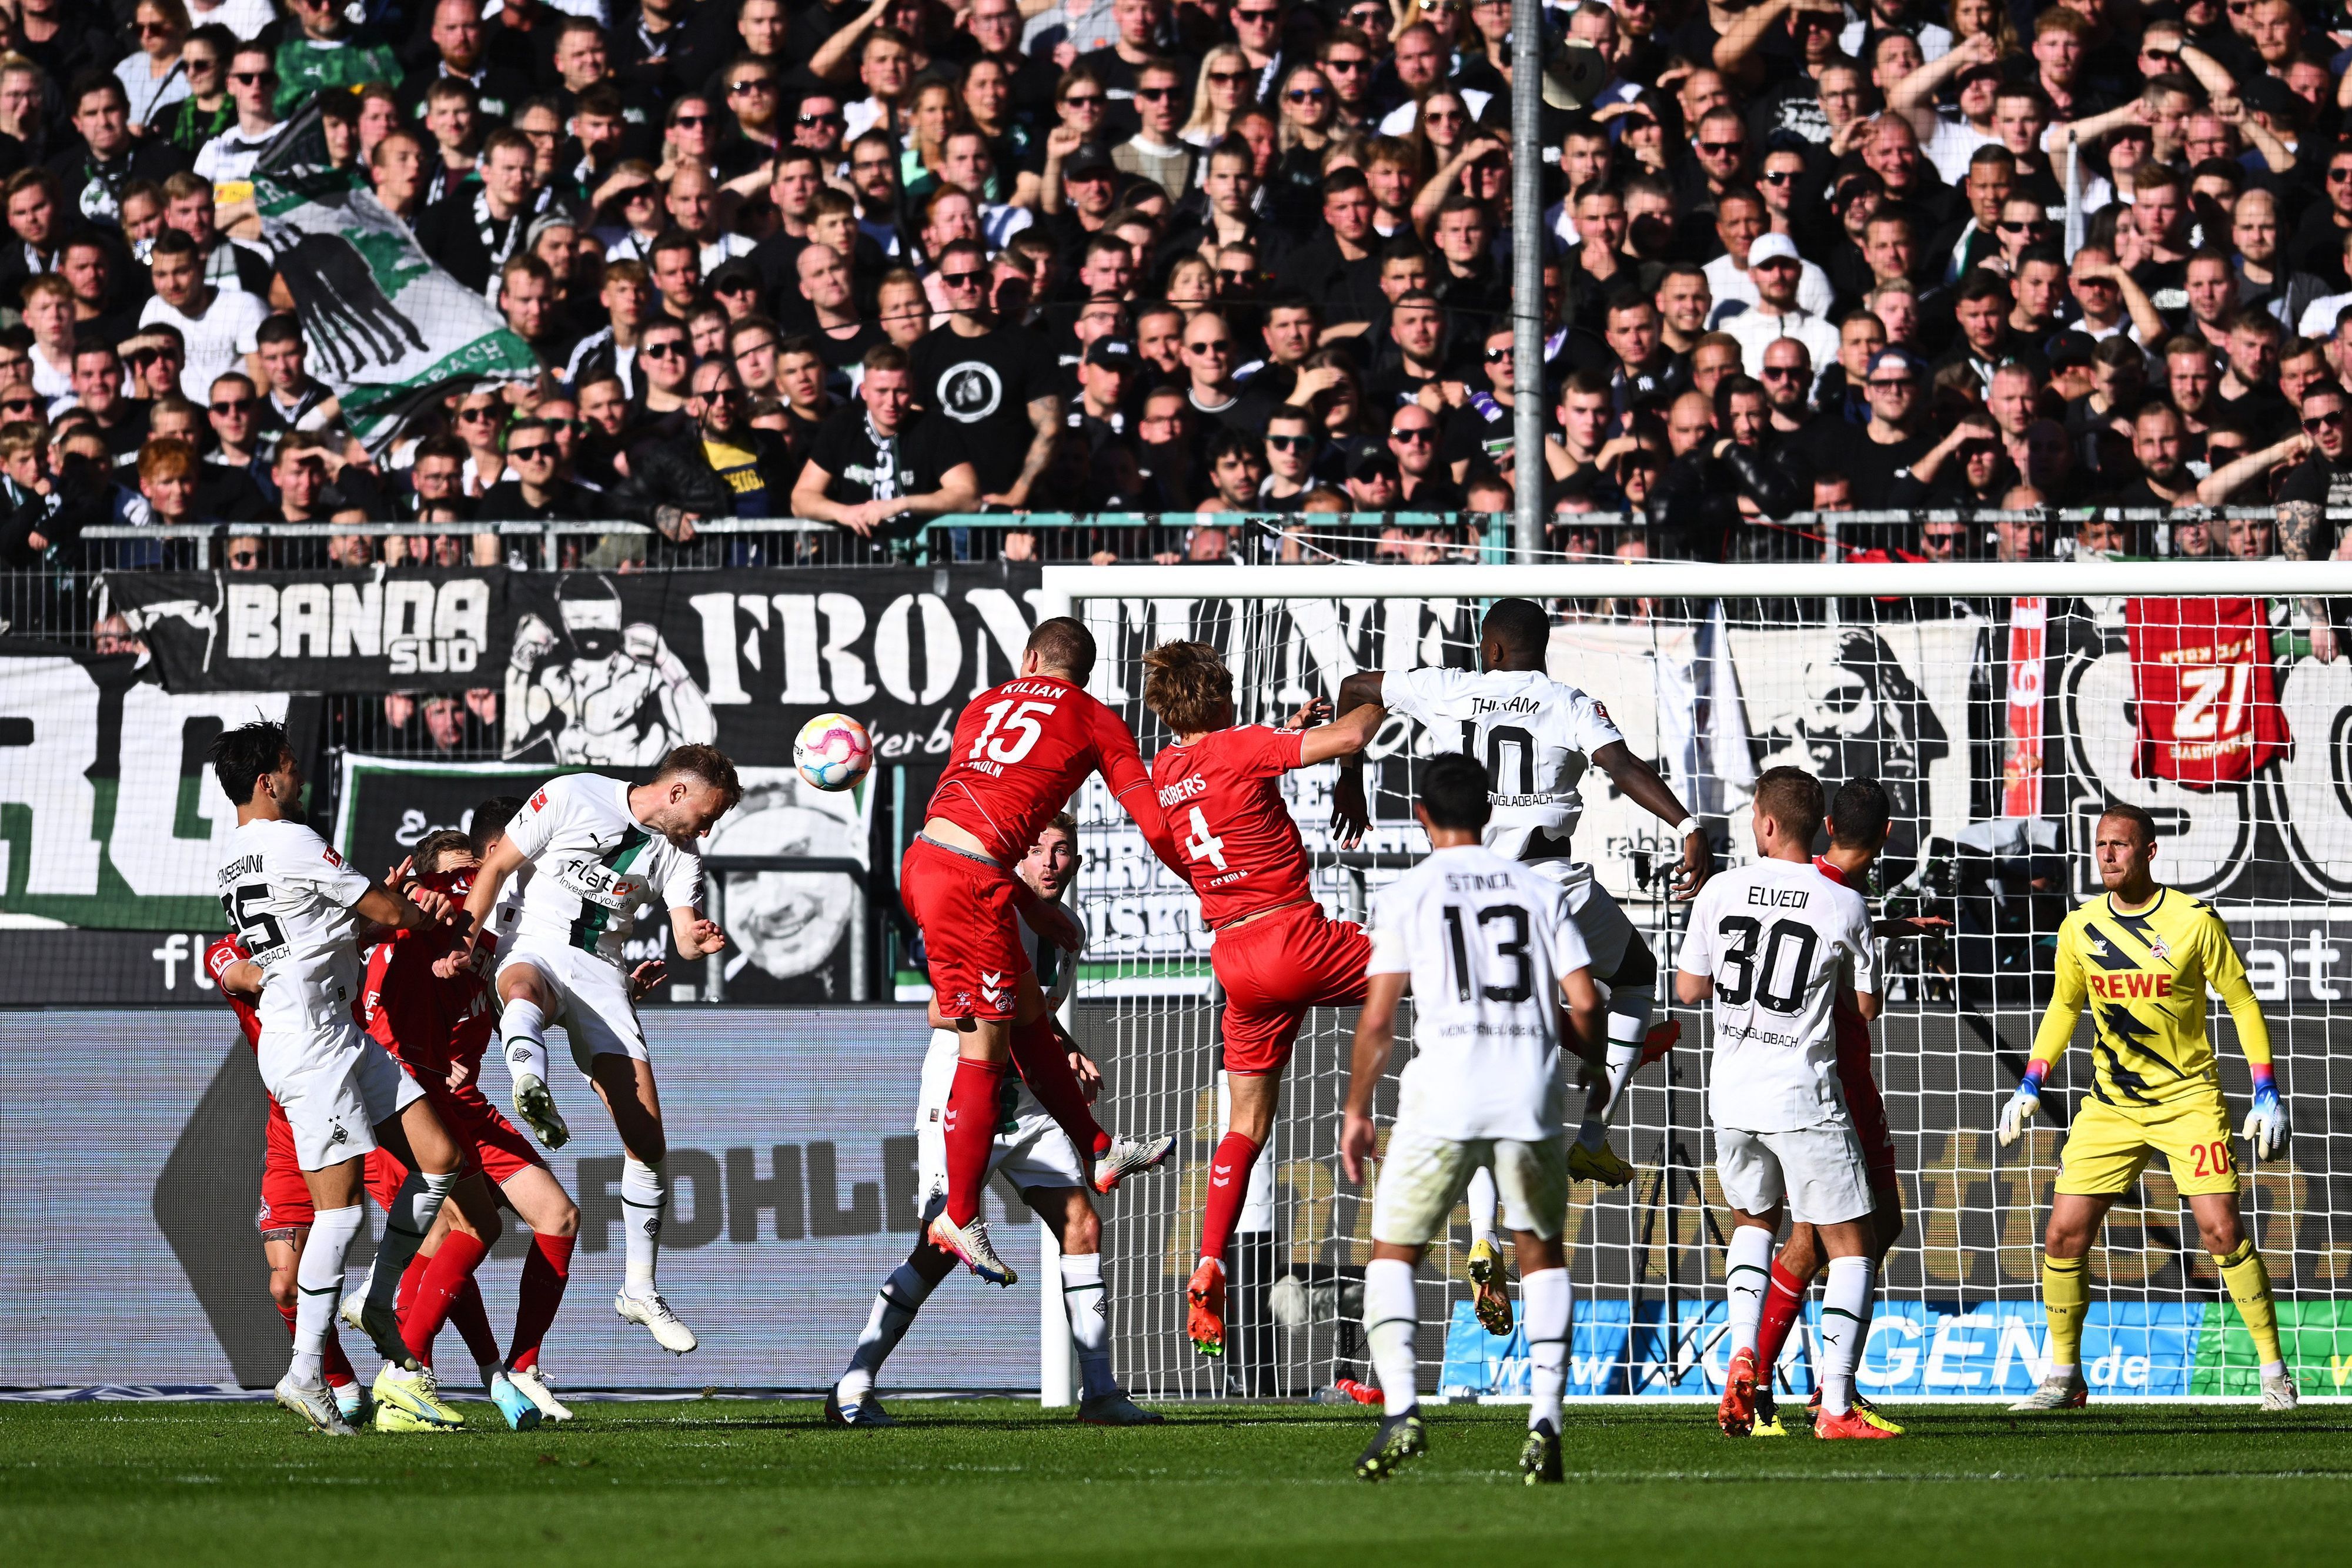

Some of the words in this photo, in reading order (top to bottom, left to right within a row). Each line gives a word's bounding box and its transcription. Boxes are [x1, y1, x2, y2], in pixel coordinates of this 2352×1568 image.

[228, 579, 489, 659] BANDA
[389, 638, 478, 674] SUD
[1001, 682, 1068, 699] KILIAN
[968, 699, 1057, 764] 15
[1461, 720, 1536, 795] 10
[1185, 805, 1229, 872] 4
[559, 876, 590, 898] Invest
[588, 891, 597, 901] in
[1748, 886, 1810, 910] ELVEDI
[1444, 904, 1532, 1003] 13
[1715, 915, 1820, 1015] 30
[2090, 973, 2173, 998] REWE
[2190, 1141, 2229, 1178] 20
[391, 1413, 416, 1425] ULTRA
